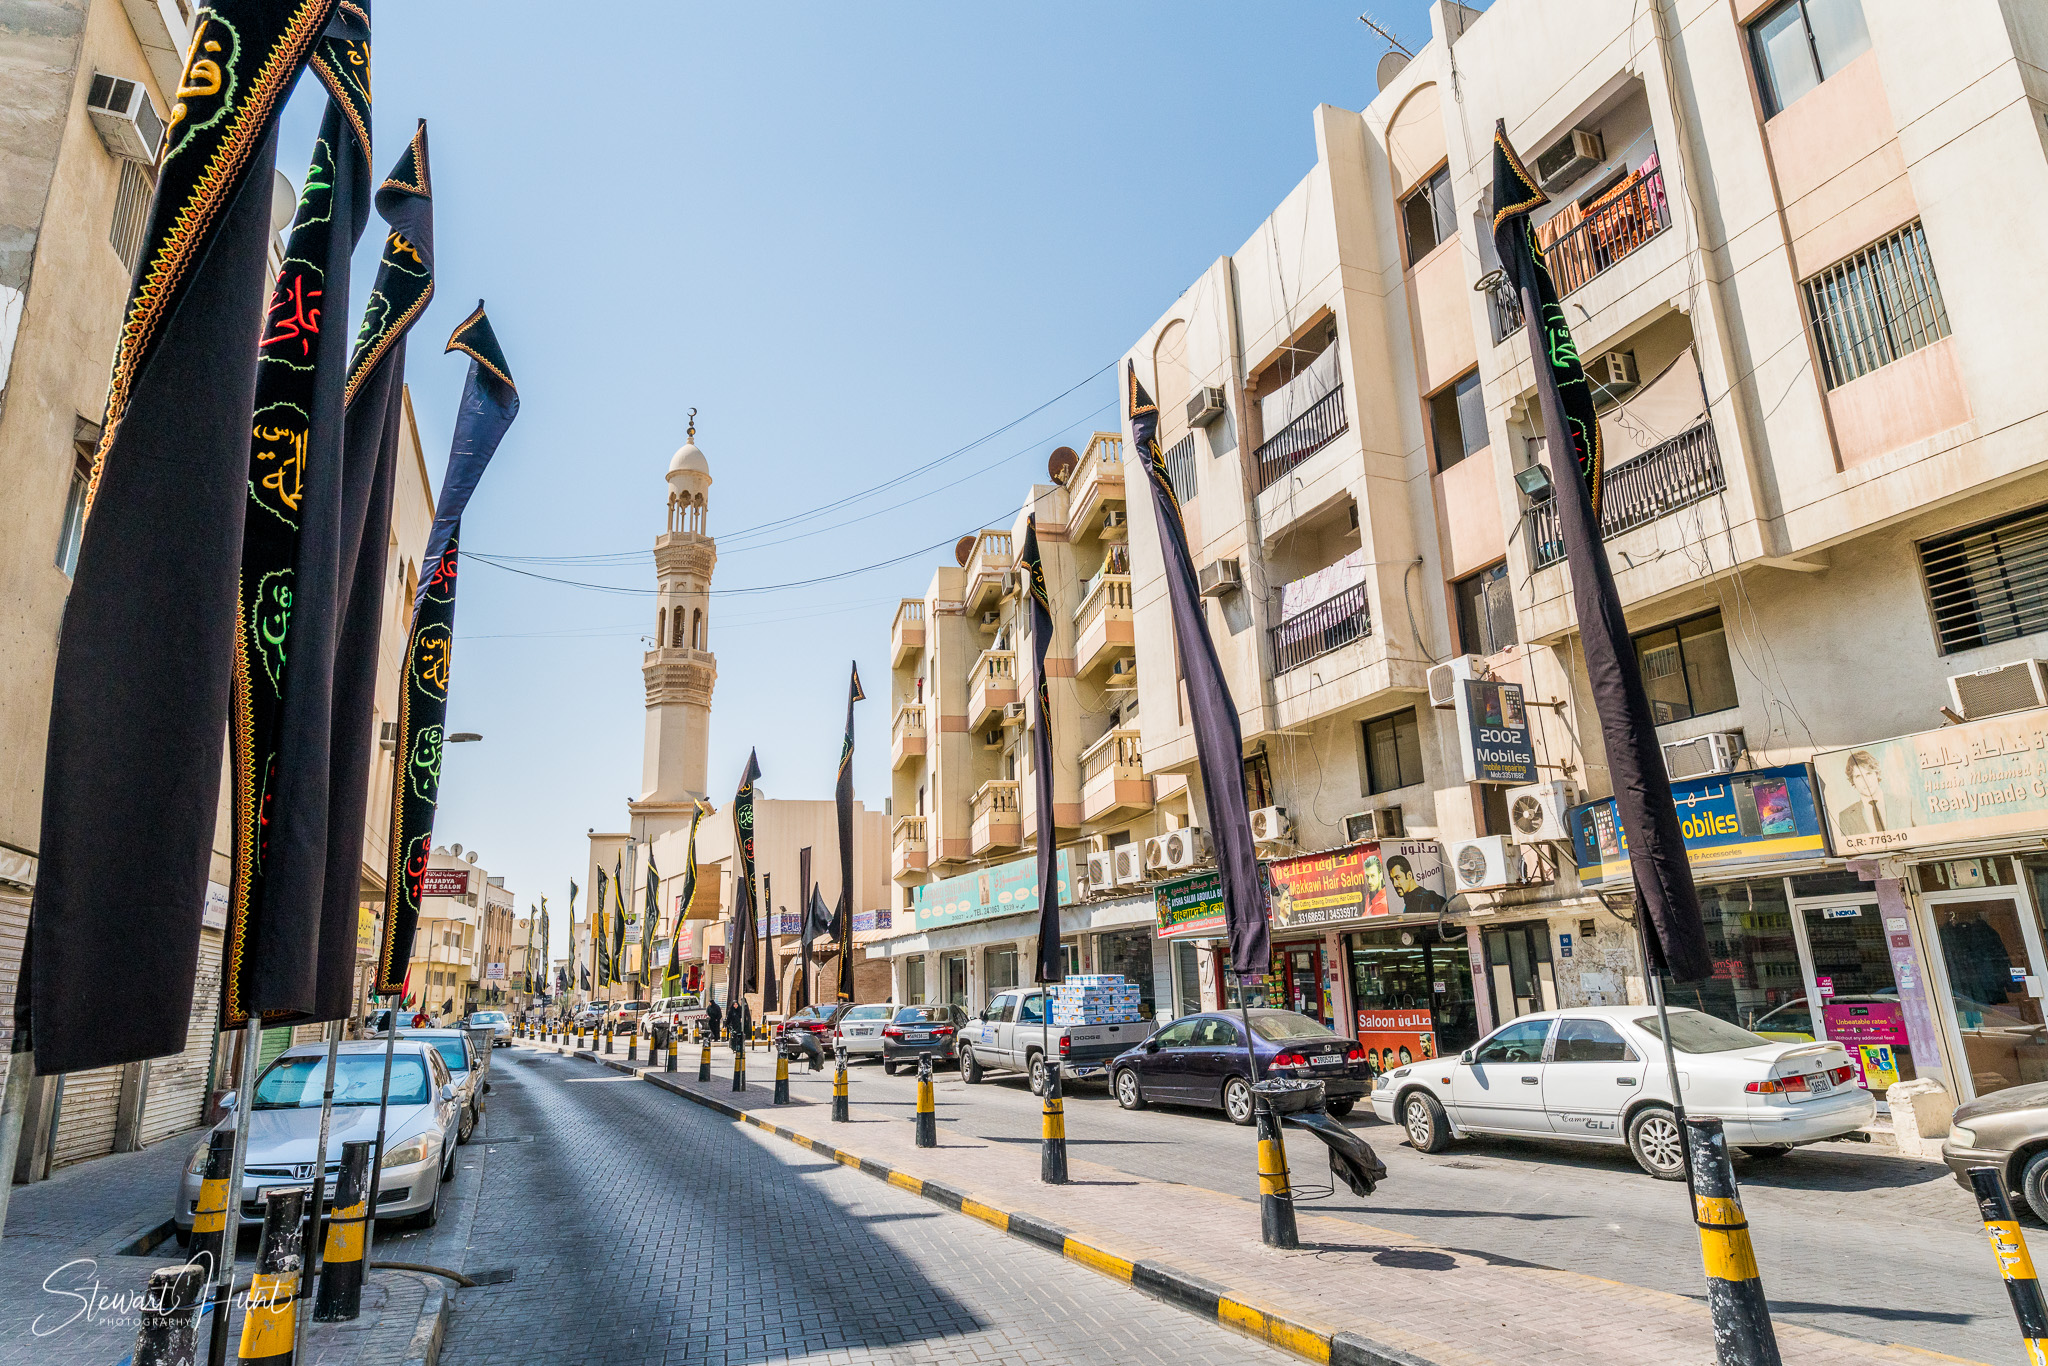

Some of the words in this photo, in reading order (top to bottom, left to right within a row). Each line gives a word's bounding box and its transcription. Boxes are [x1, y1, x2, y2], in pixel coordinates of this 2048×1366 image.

[1480, 729, 1521, 744] 2002
[1477, 748, 1531, 764] Mobiles
[1502, 764, 1526, 774] repairing
[1924, 776, 1965, 793] Husain
[1970, 764, 2032, 785] Mohamed
[1928, 783, 2028, 814] Readymade
[1677, 810, 1739, 839] obiles
[1869, 832, 1908, 846] 7763-10
[1701, 849, 1742, 860] Accessories
[1416, 866, 1440, 882] Saloon
[1290, 877, 1322, 896] Makkawi
[1324, 875, 1339, 890] Hair
[1340, 872, 1364, 888] Salon
[1197, 891, 1216, 902] ABDULLA
[1713, 960, 1742, 968] imSim
[1360, 1014, 1395, 1027] Saloon
[1398, 1014, 1432, 1027] صالون
[1586, 1121, 1614, 1129] GLi
